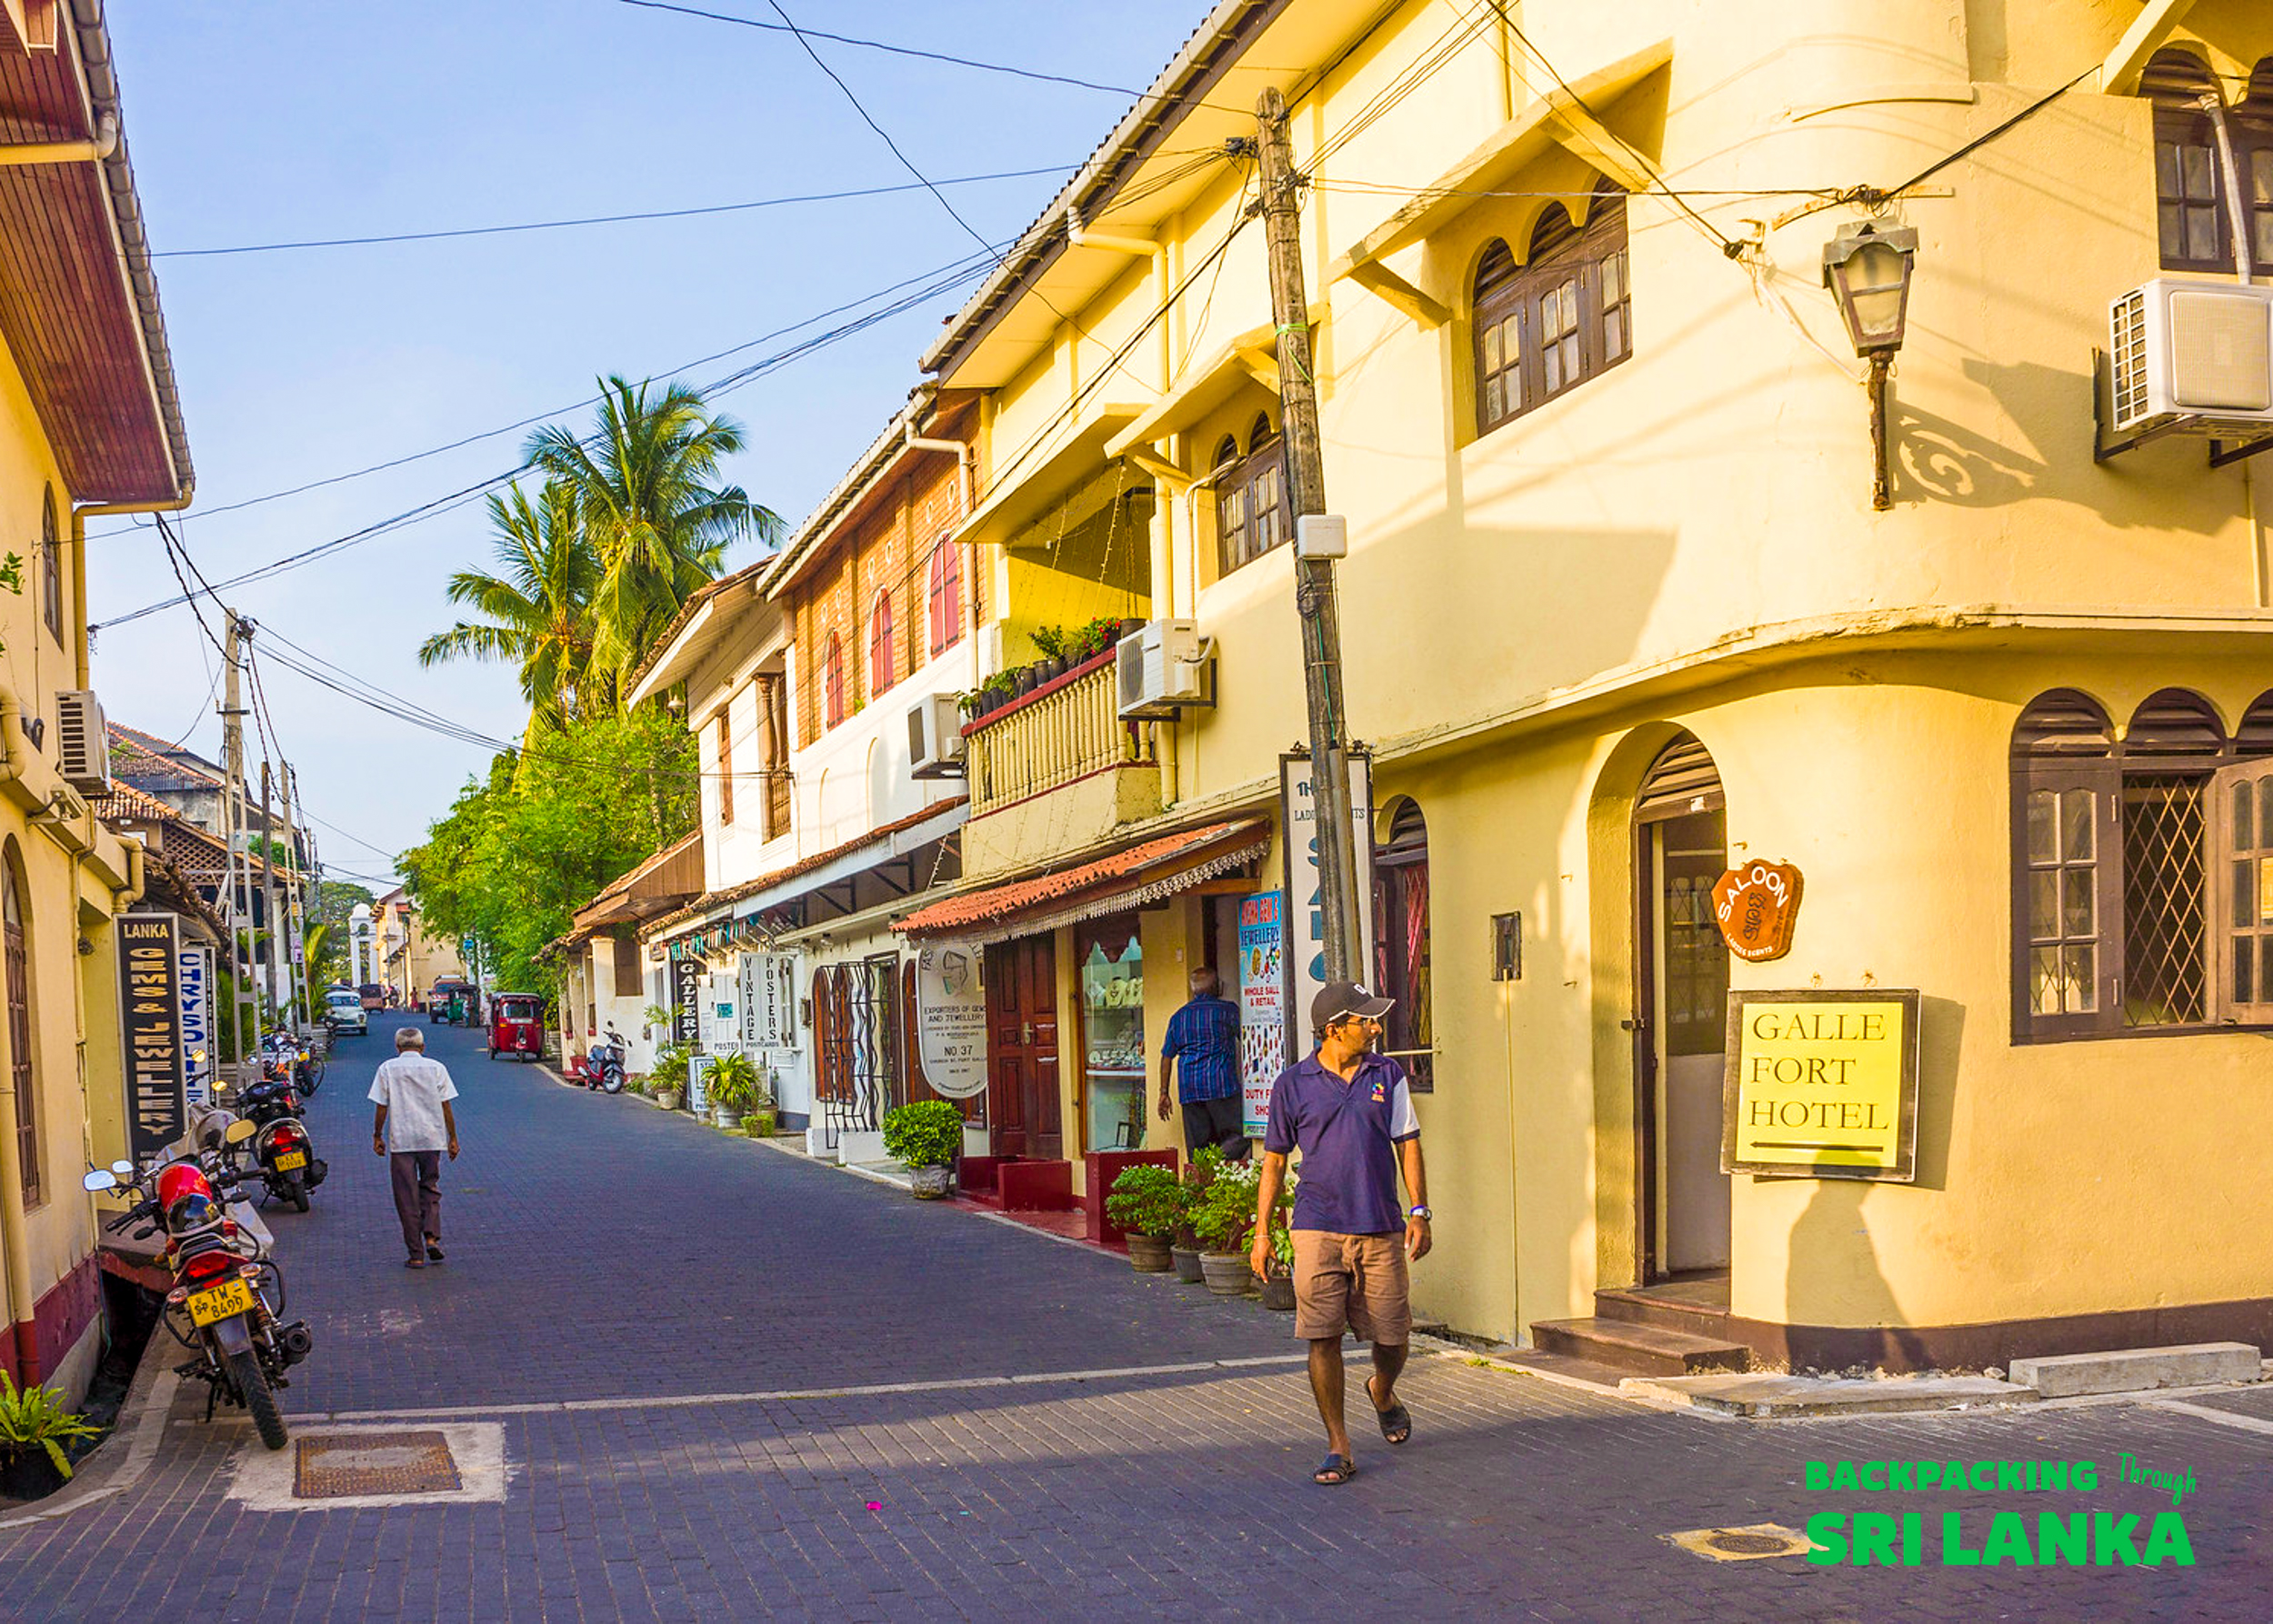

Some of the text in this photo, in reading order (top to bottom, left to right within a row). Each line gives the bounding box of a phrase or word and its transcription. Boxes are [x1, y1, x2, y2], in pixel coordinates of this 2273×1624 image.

[1718, 867, 1788, 922] SALOON
[124, 924, 169, 938] LANKA
[129, 947, 168, 997] GEMS
[133, 1002, 168, 1014] &
[680, 964, 697, 1039] GALLERY
[745, 957, 755, 1040] VINTAGE
[766, 957, 776, 1040] POSTERS
[1256, 997, 1276, 1007] RETAIL
[928, 1015, 943, 1023] AND
[1753, 1013, 1886, 1040] GALLE
[944, 1044, 973, 1057] NO 37
[134, 1021, 175, 1135] JEWELLERY
[1750, 1057, 1857, 1085] FORT
[1246, 1088, 1264, 1099] DUTY
[1748, 1100, 1889, 1129] HOTEL
